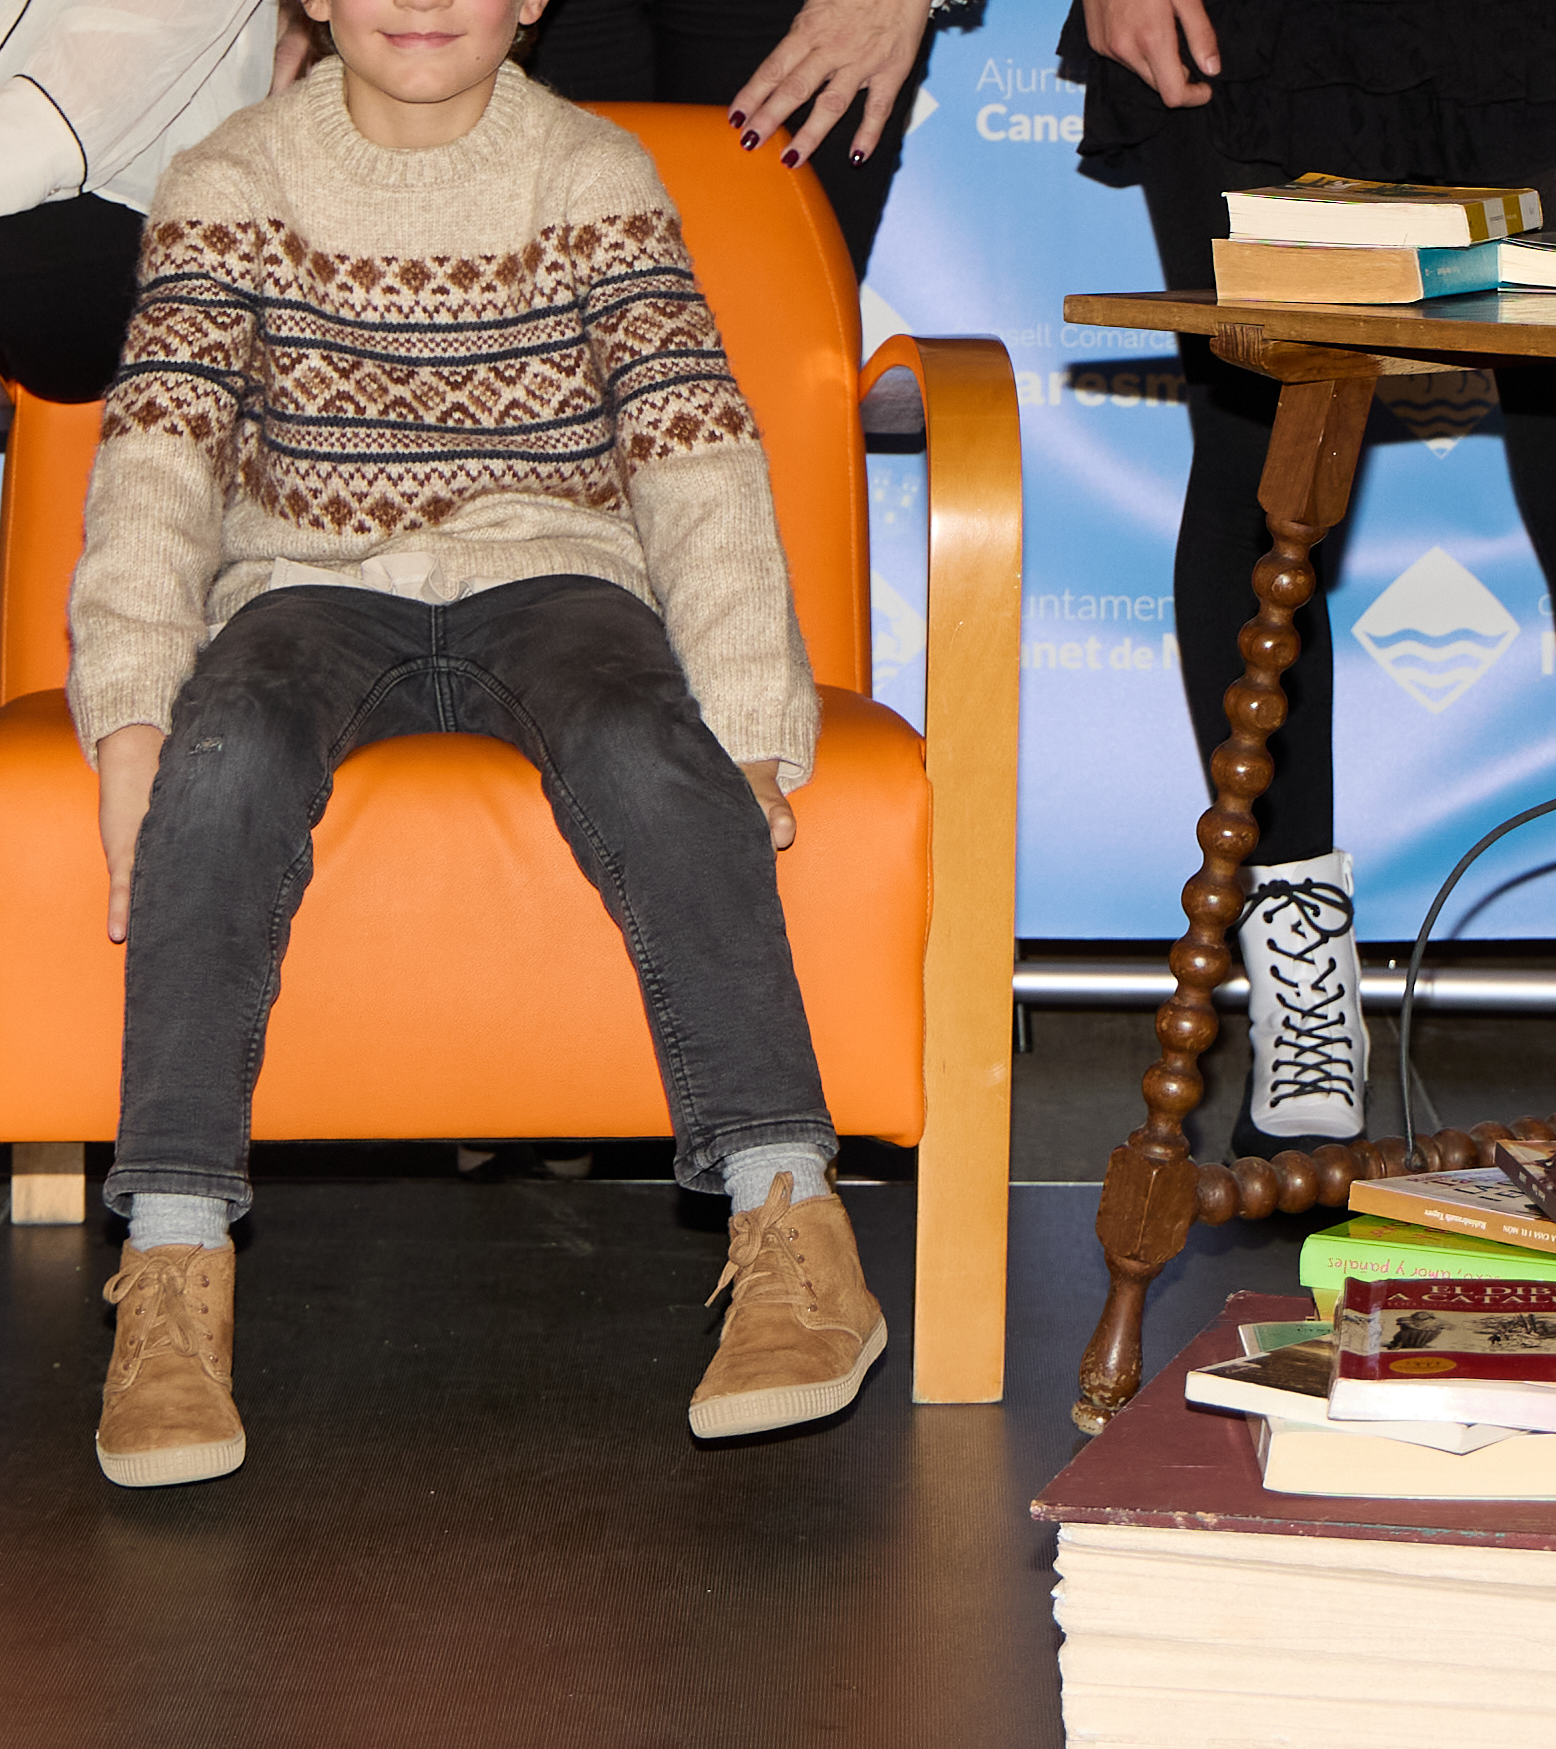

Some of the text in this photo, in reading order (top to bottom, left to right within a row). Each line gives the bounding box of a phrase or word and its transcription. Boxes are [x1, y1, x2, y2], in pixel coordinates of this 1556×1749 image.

[976, 103, 1085, 143] Cane
[1109, 637, 1154, 670] de
[1326, 1256, 1391, 1276] pañales
[1395, 1261, 1406, 1277] y
[1430, 1284, 1475, 1295] EL
